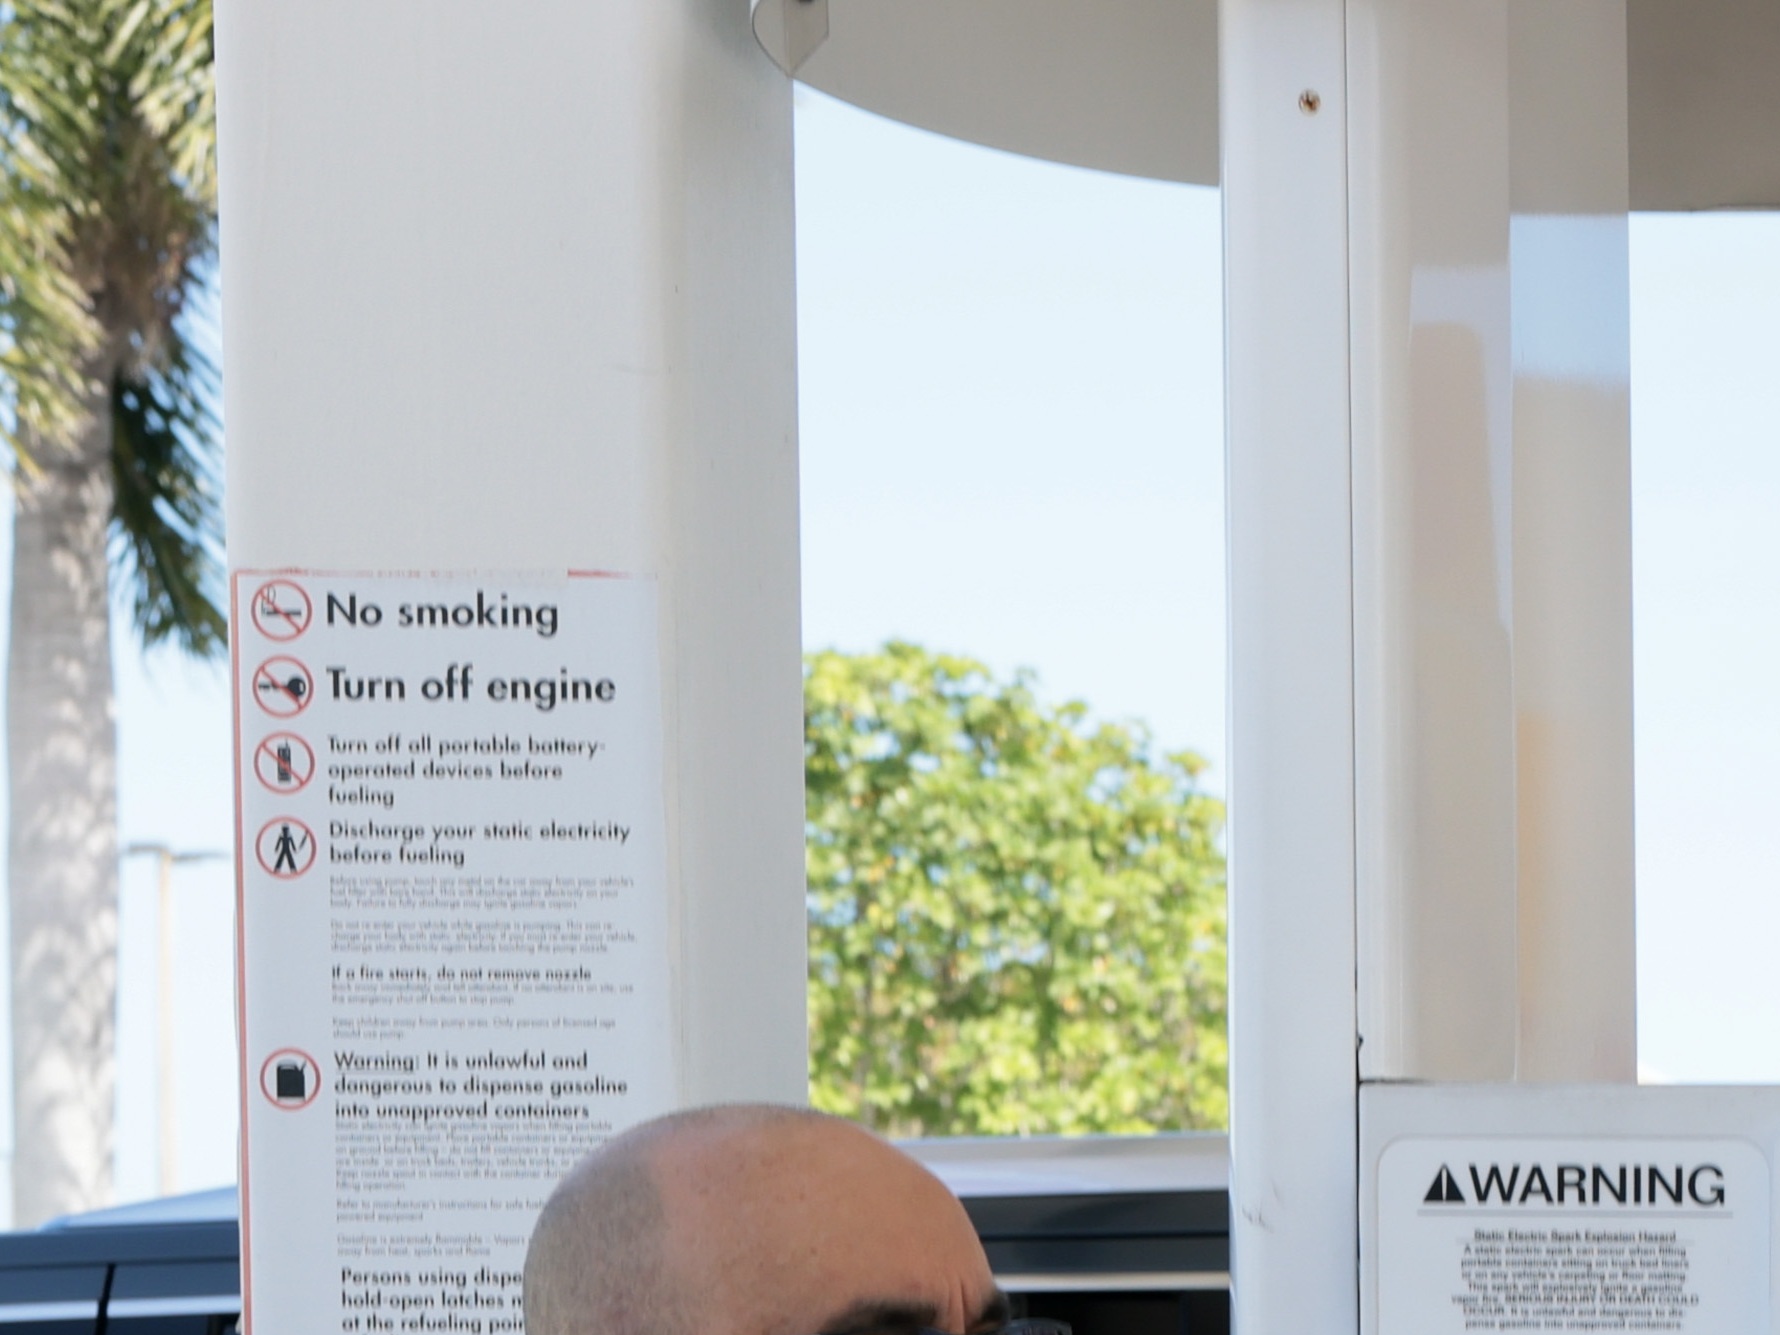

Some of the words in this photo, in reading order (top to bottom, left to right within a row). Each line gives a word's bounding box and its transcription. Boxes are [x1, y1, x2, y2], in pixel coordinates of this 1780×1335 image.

[326, 592, 383, 627] No
[398, 590, 559, 638] smoking
[326, 667, 406, 700] Turn
[420, 664, 473, 701] off
[487, 667, 617, 712] engine
[328, 736, 368, 754] Turn
[375, 735, 400, 754] off
[408, 735, 432, 754] all
[438, 735, 521, 758] portable
[328, 760, 415, 782] operated
[422, 760, 493, 779] devices
[500, 760, 563, 779] before
[328, 785, 395, 808] fueling
[329, 820, 425, 843] Discharge
[432, 826, 474, 843] your
[484, 822, 530, 840] static
[539, 820, 631, 844] electricity
[329, 845, 392, 863] before
[399, 845, 465, 867] fueling
[334, 1052, 420, 1070] Warning:
[426, 1052, 438, 1070] It
[444, 1052, 458, 1070] is
[465, 1051, 546, 1070] unlawful
[553, 1052, 588, 1070] and
[334, 1076, 432, 1097] dangerous
[439, 1077, 457, 1093] to
[463, 1076, 543, 1097] dispense
[550, 1076, 628, 1097] gasoline
[334, 1102, 370, 1118] into
[376, 1101, 488, 1121] unapproved
[494, 1102, 590, 1119] containers
[1469, 1163, 1725, 1206] WARNING
